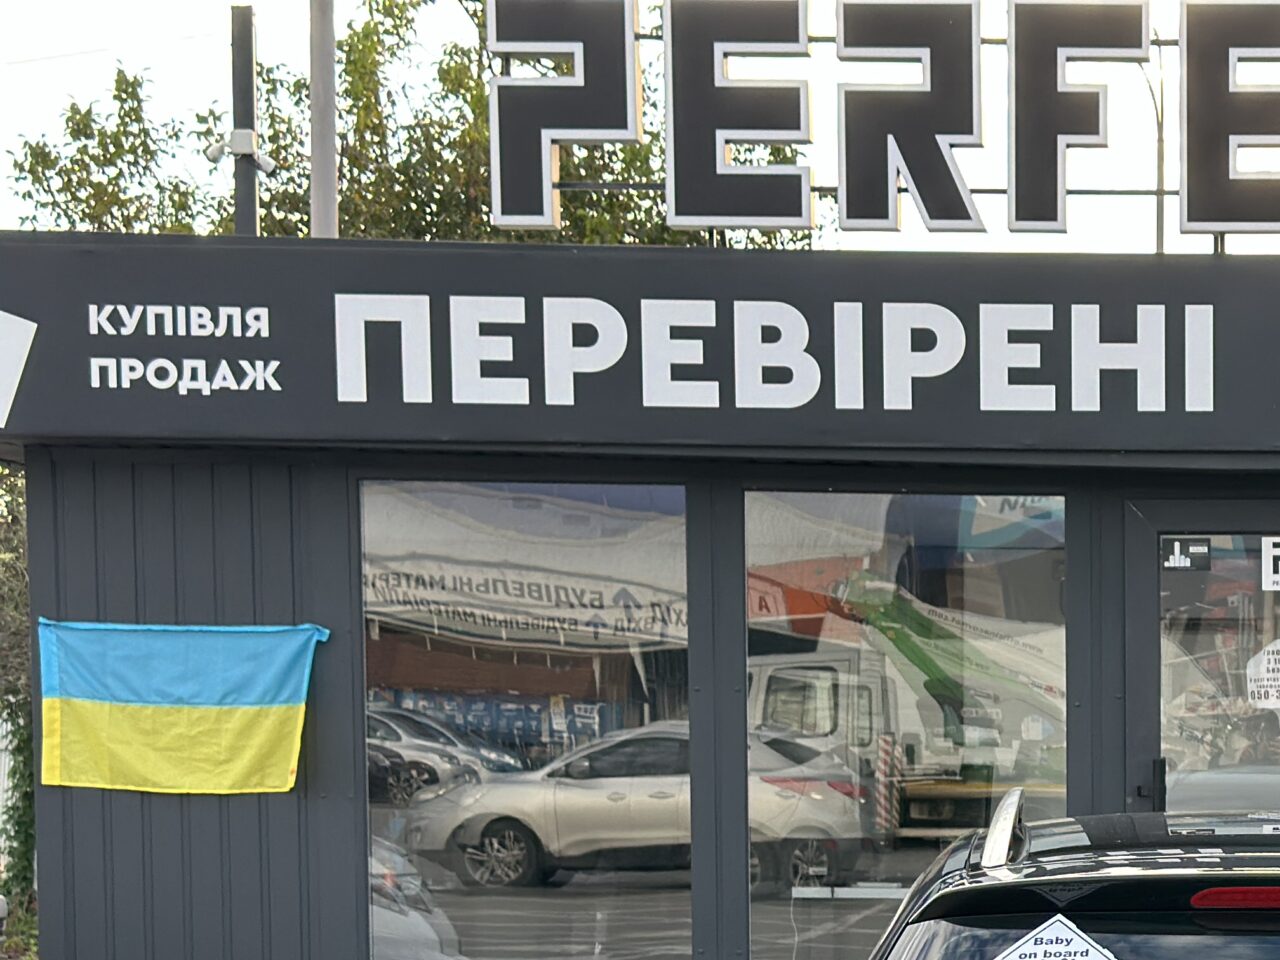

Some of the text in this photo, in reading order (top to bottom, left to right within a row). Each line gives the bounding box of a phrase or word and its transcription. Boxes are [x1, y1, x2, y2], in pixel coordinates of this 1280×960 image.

[88, 303, 270, 339] КУПІВЛЯ
[334, 293, 1215, 413] ПЕРЕВІРЕНІ
[89, 356, 283, 396] ПРОДАЖ
[1018, 948, 1089, 960] on board
[1033, 936, 1074, 947] Baby
